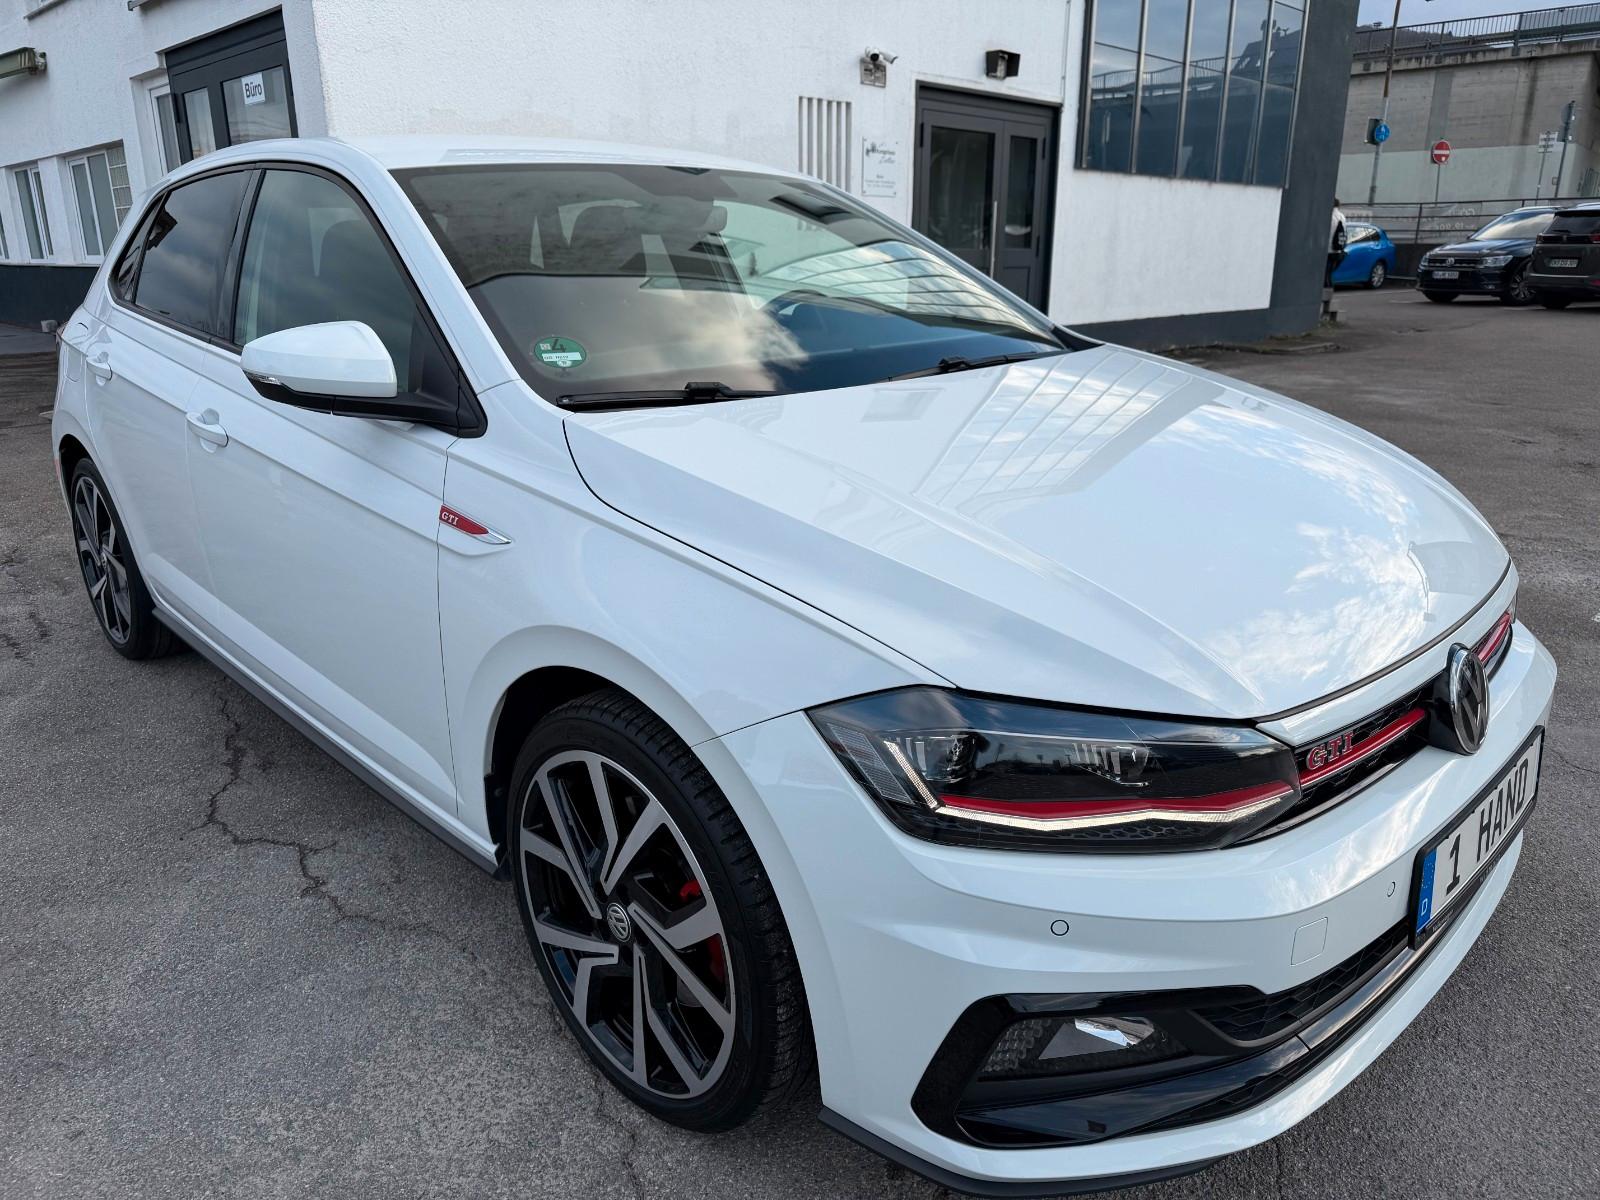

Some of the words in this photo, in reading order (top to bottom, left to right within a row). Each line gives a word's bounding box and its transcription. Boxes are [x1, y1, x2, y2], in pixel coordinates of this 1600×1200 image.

[244, 82, 262, 98] Büro
[551, 338, 566, 353] 4
[441, 511, 459, 526] GTI
[1306, 730, 1354, 771] GTI
[1446, 833, 1461, 896] 1
[1476, 758, 1528, 863] HAND
[1420, 898, 1428, 916] D
